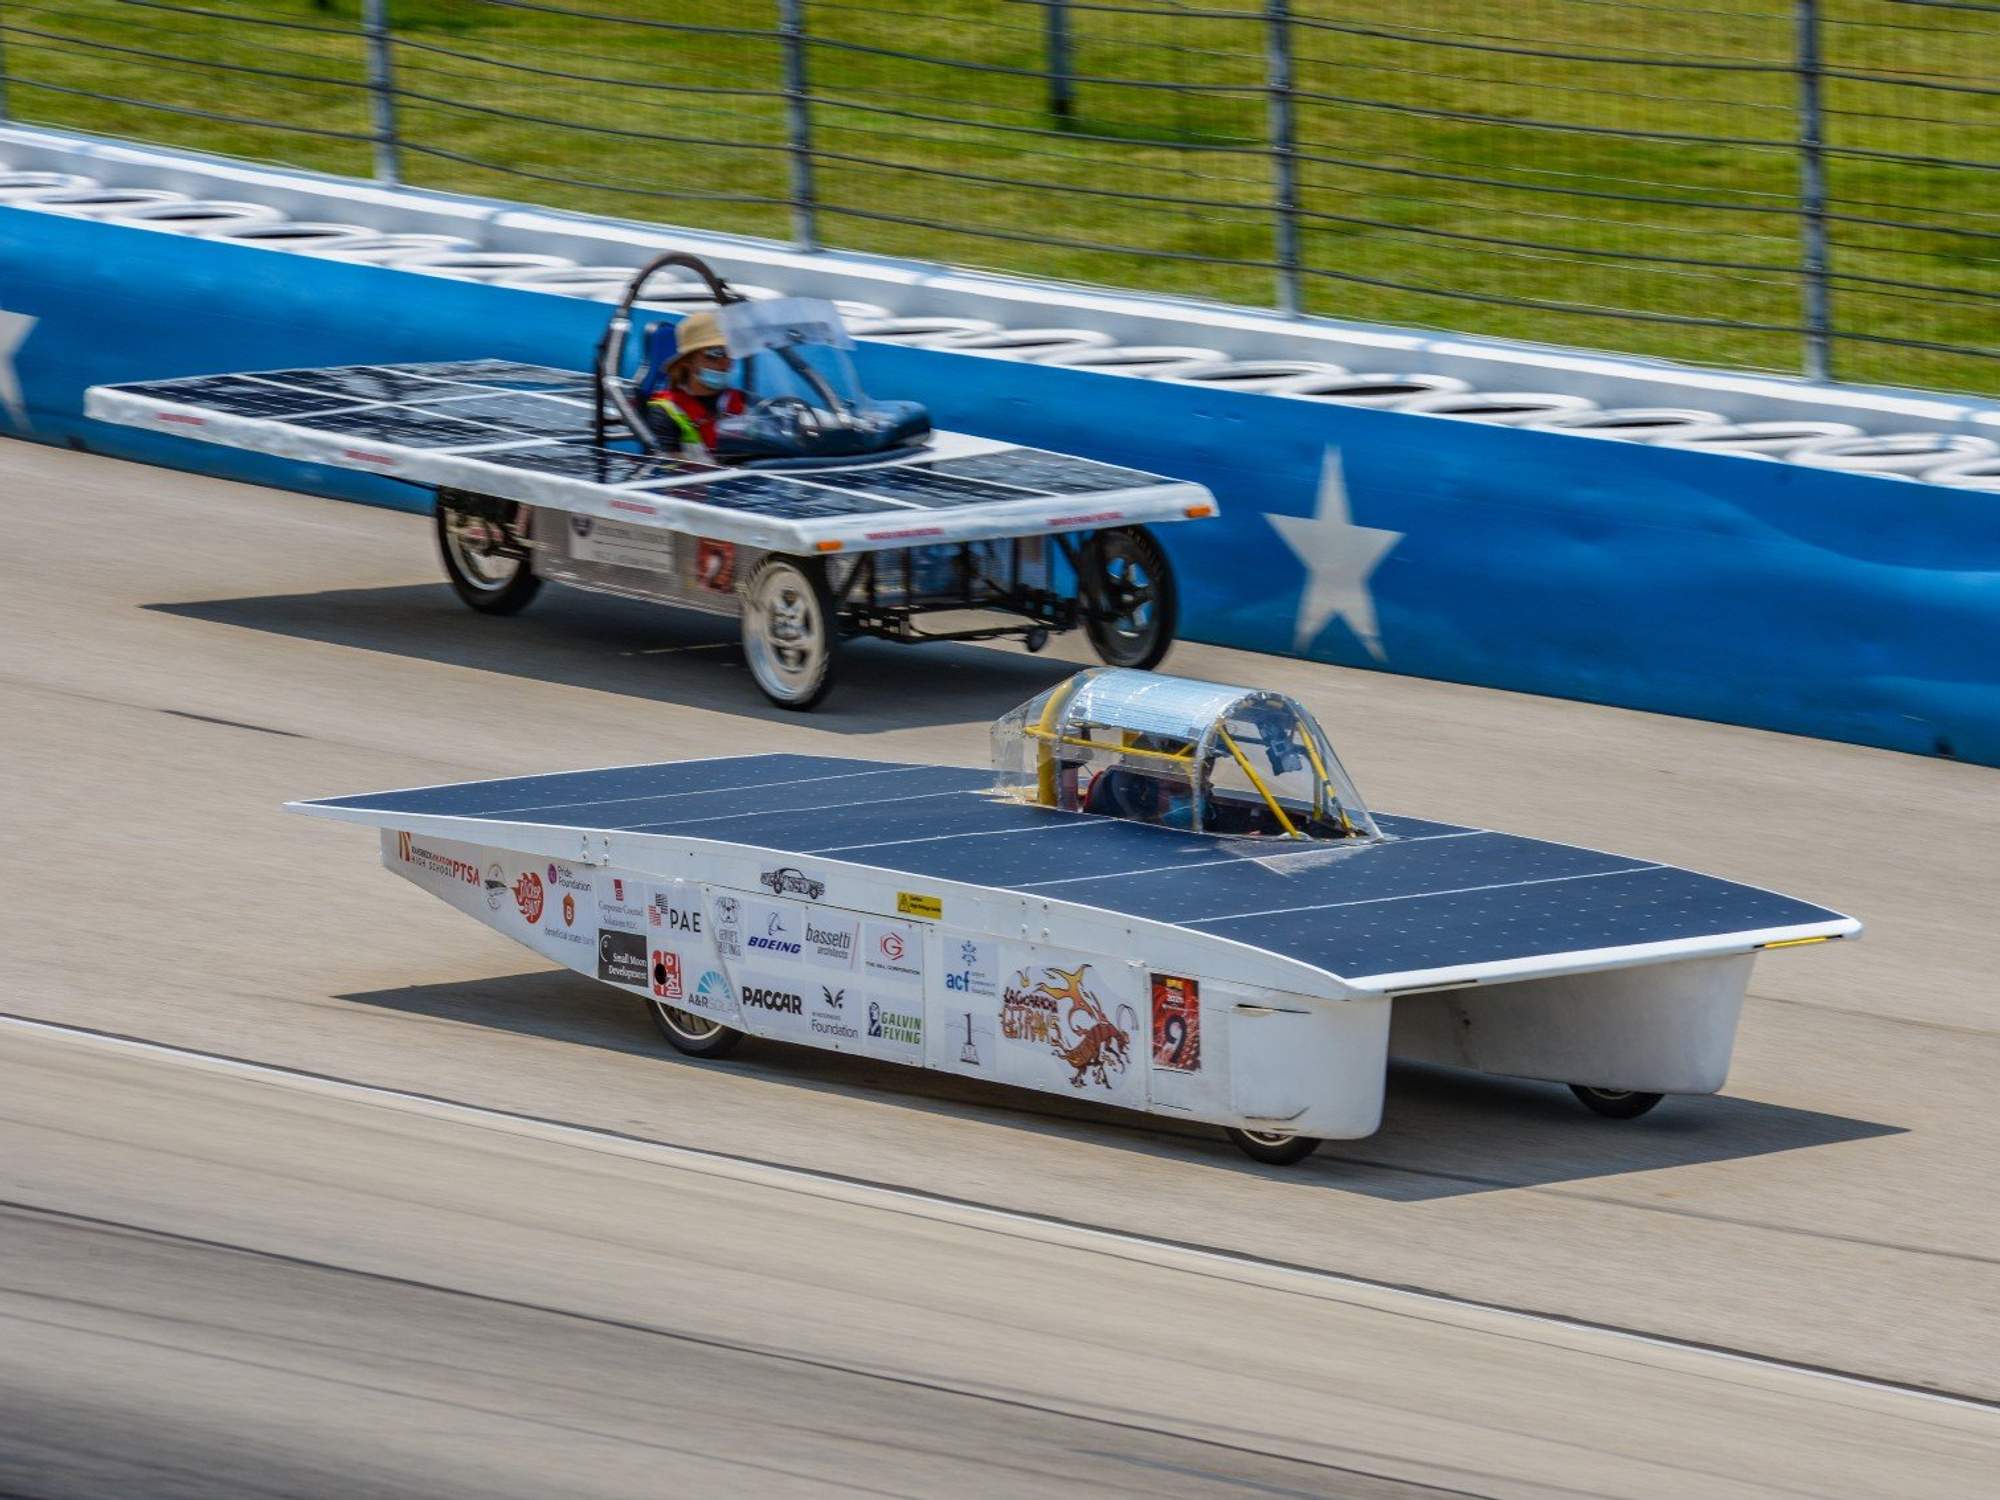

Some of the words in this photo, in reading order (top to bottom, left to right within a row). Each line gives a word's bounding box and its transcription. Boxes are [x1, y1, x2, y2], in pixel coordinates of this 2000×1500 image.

[428, 861, 453, 877] SCHOOL
[452, 861, 480, 887] PTSA
[557, 865, 573, 878] Pride
[559, 877, 592, 892] Foundation
[566, 904, 573, 920] B
[669, 909, 702, 933] PAE
[748, 936, 801, 954] BOEING
[806, 922, 850, 950] bassetti
[613, 952, 630, 963] Small
[630, 956, 648, 968] Moon
[817, 946, 848, 960] architects
[608, 965, 648, 981] Development
[945, 971, 971, 992] acf
[688, 993, 709, 1009] A&R
[741, 985, 804, 1015] PACCAR
[811, 1018, 859, 1040] Foundation
[881, 1011, 921, 1030] GALVIN
[883, 1026, 921, 1045] FLYING
[1164, 1014, 1187, 1064] 9
